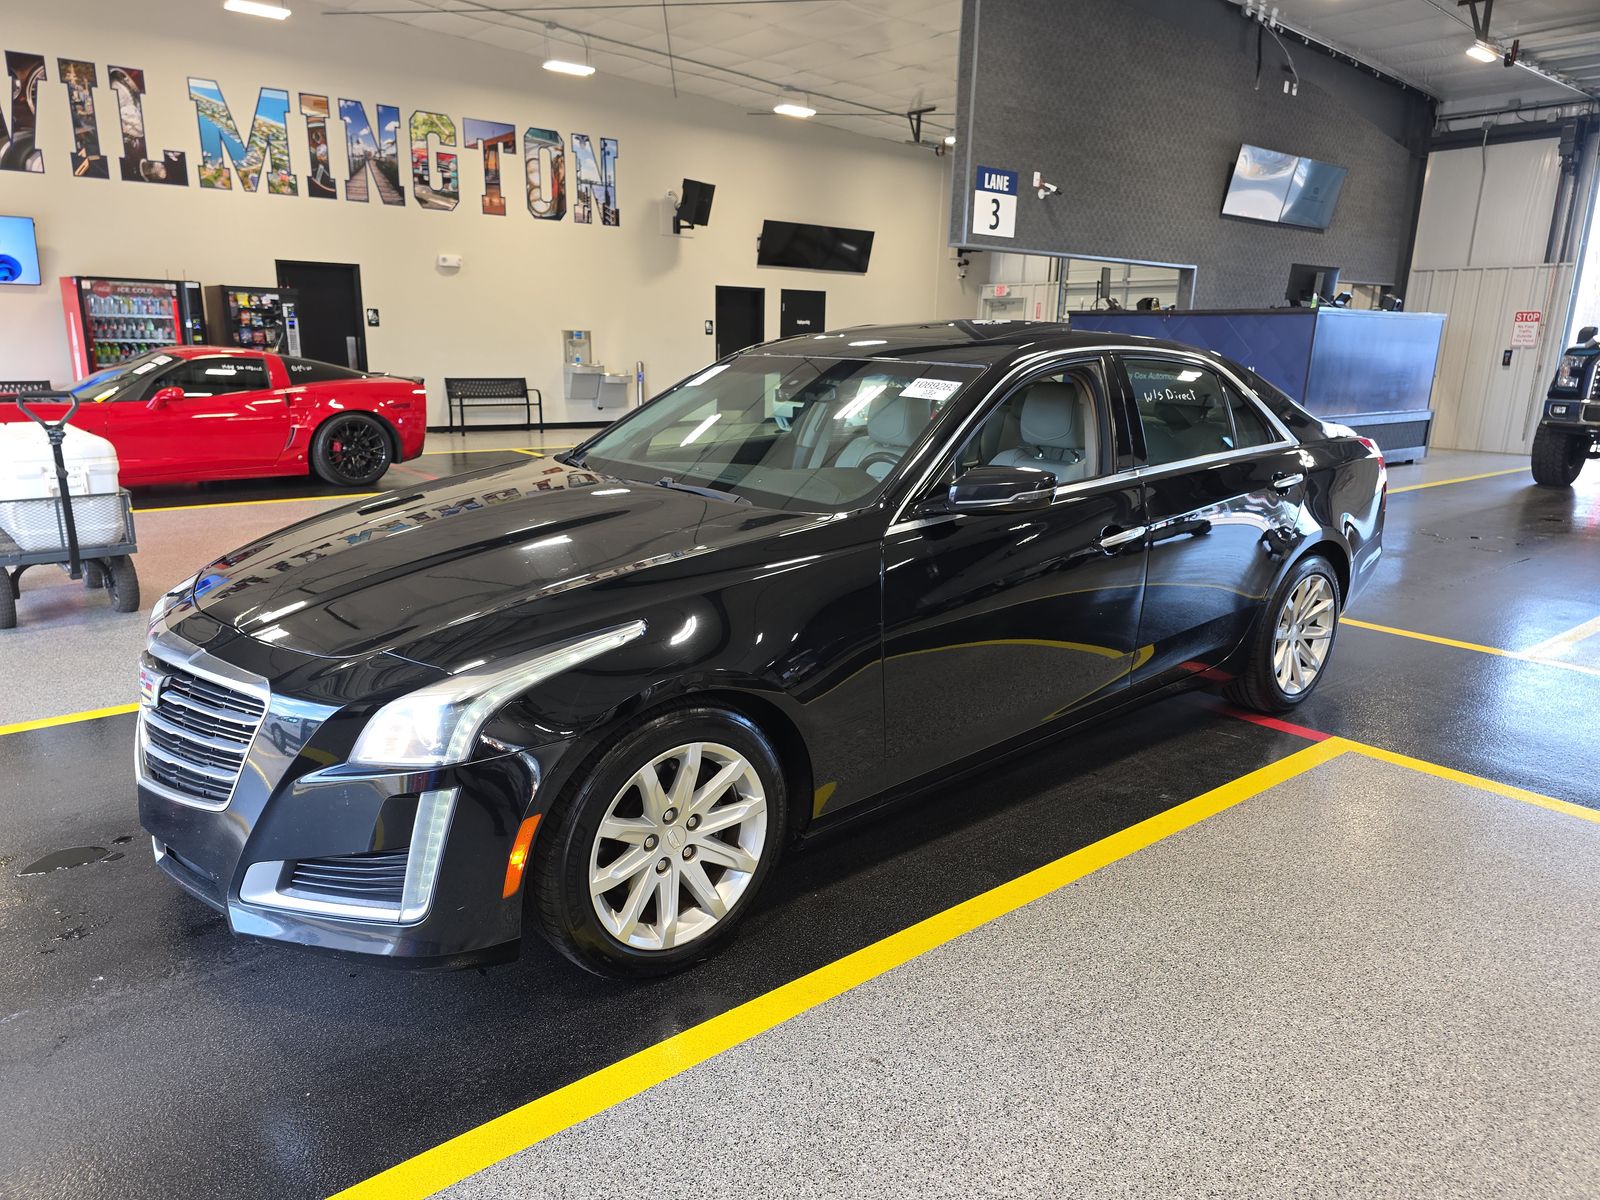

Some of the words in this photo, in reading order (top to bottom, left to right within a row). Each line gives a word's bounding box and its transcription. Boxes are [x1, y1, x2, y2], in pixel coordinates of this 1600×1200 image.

[984, 172, 1010, 191] LANE
[989, 198, 1000, 231] 3
[1515, 312, 1540, 322] STOP
